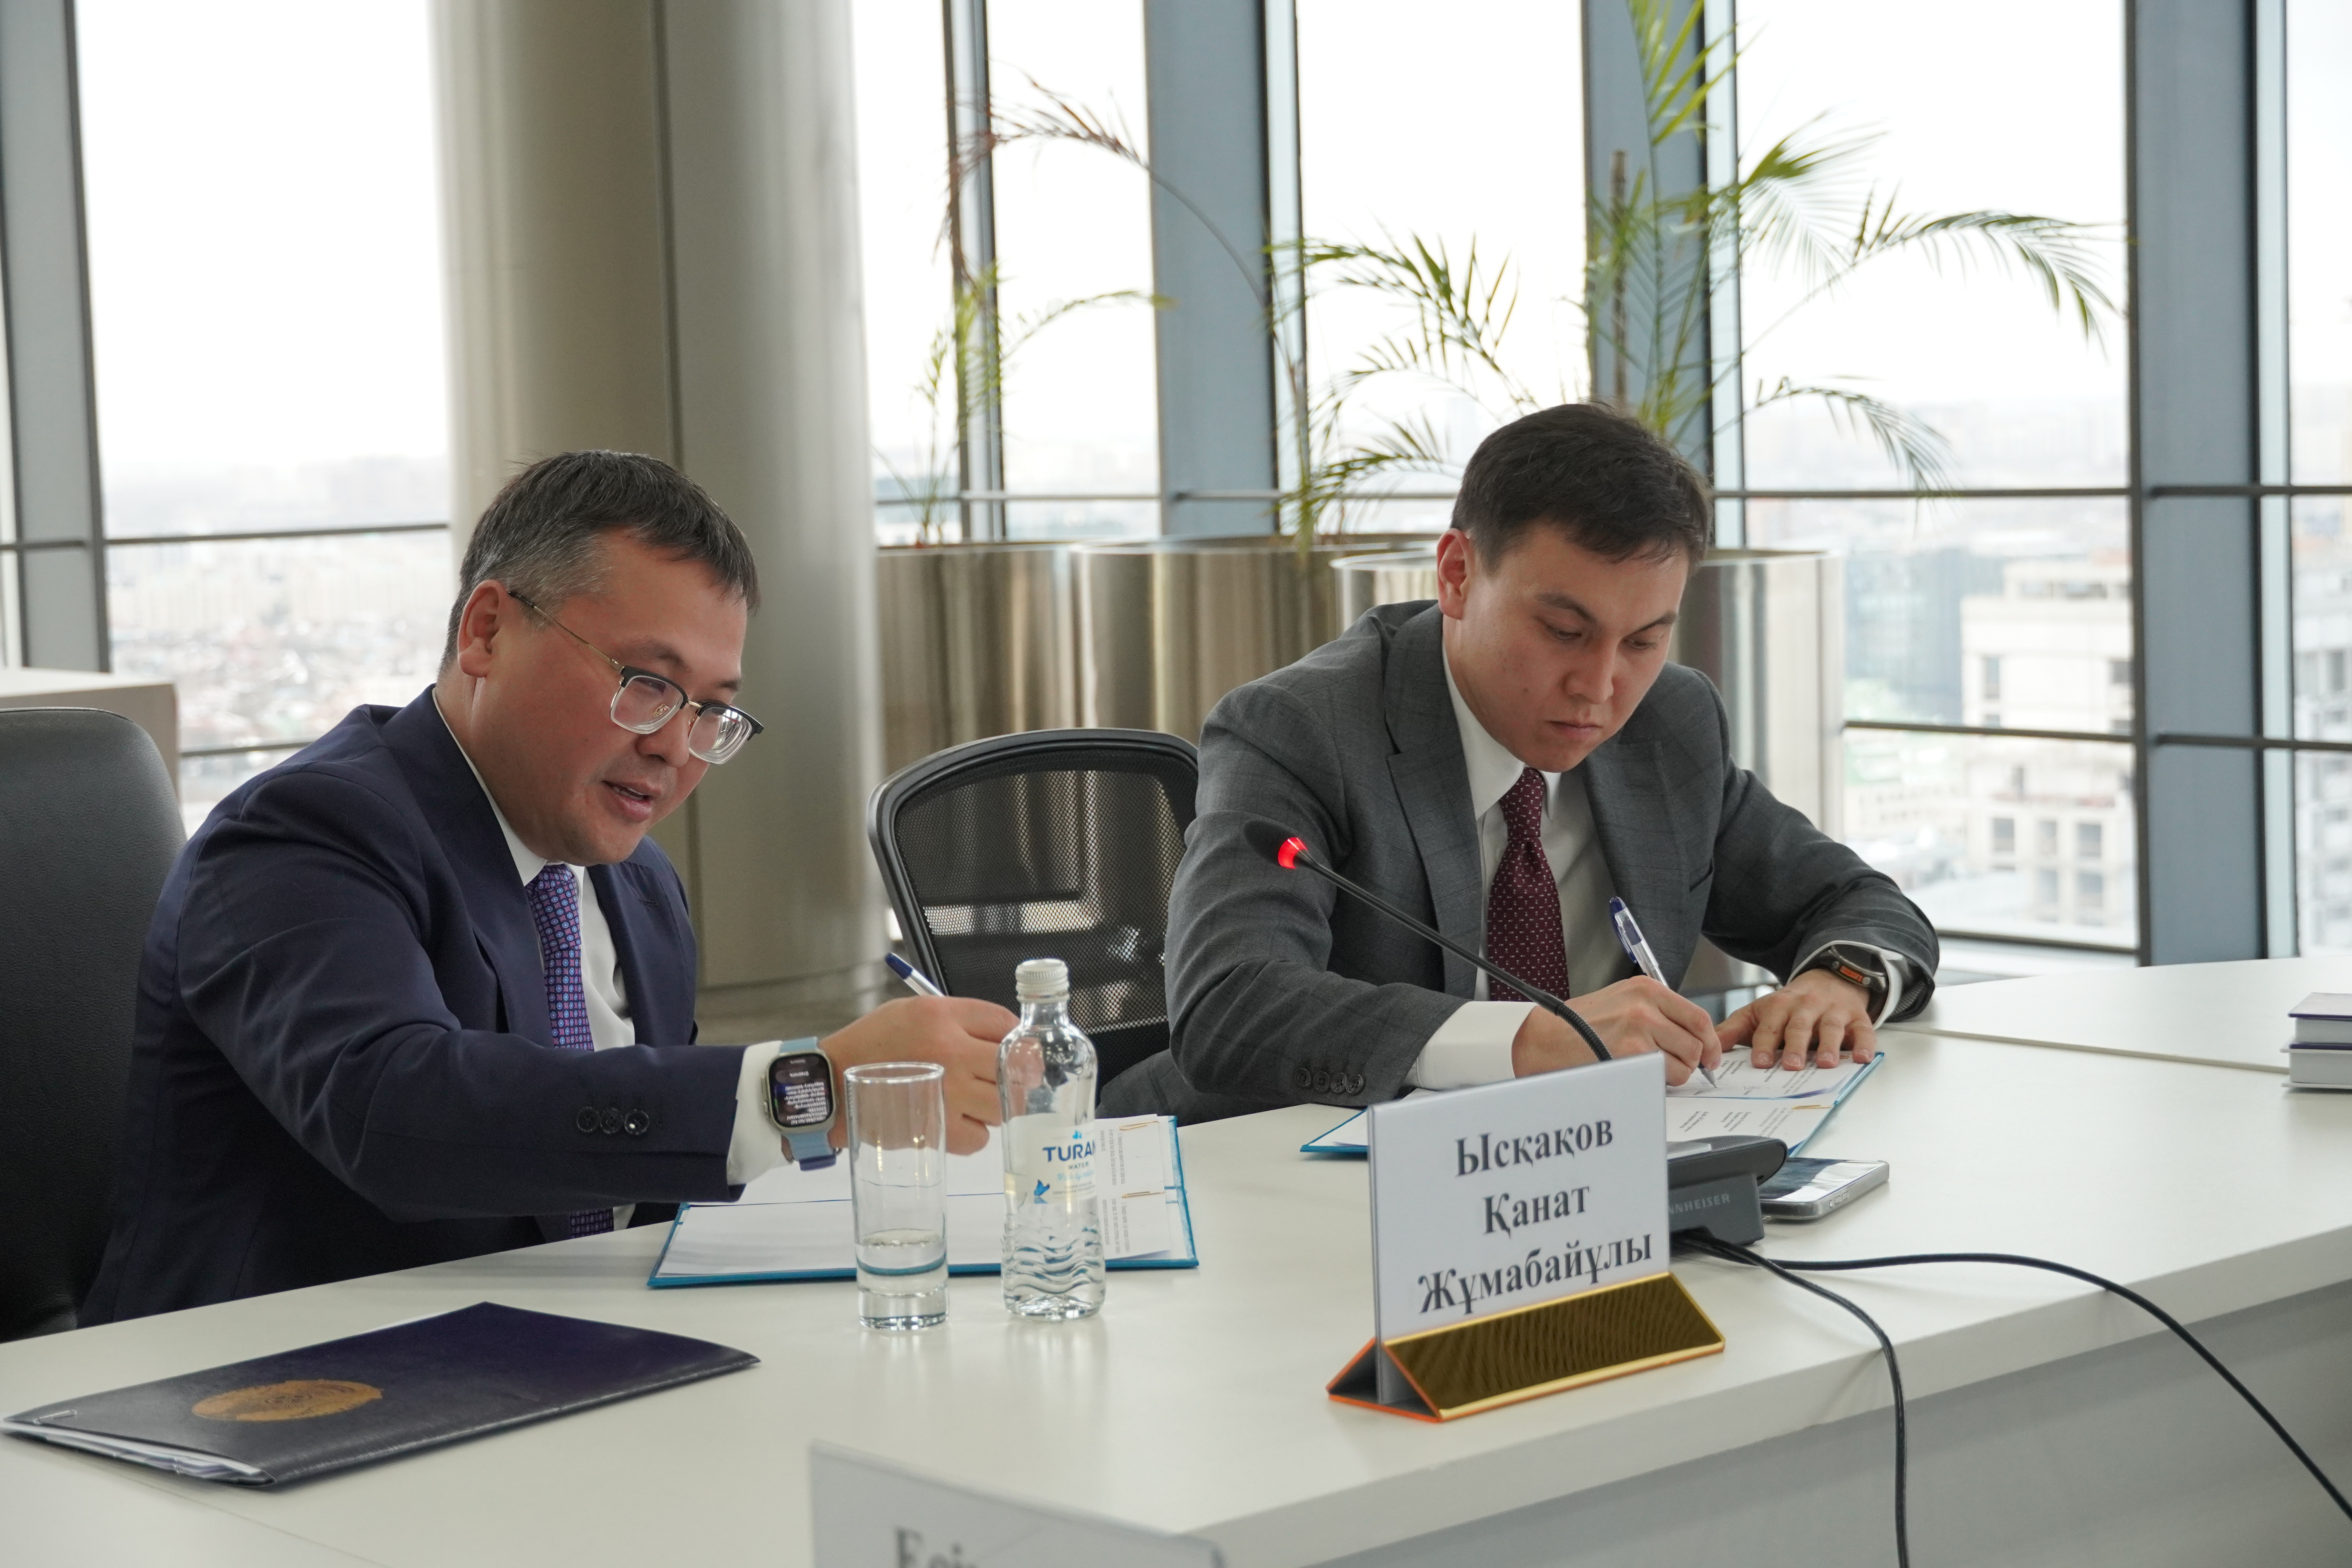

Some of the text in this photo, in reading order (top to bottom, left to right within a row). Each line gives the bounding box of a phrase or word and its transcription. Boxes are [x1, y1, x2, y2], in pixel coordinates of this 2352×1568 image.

[1455, 1120, 1613, 1176] Ысқақов
[1484, 1185, 1590, 1238] Қанат
[1669, 1193, 1730, 1214] NNHEISER
[1418, 1234, 1652, 1315] Жұмабайұлы
